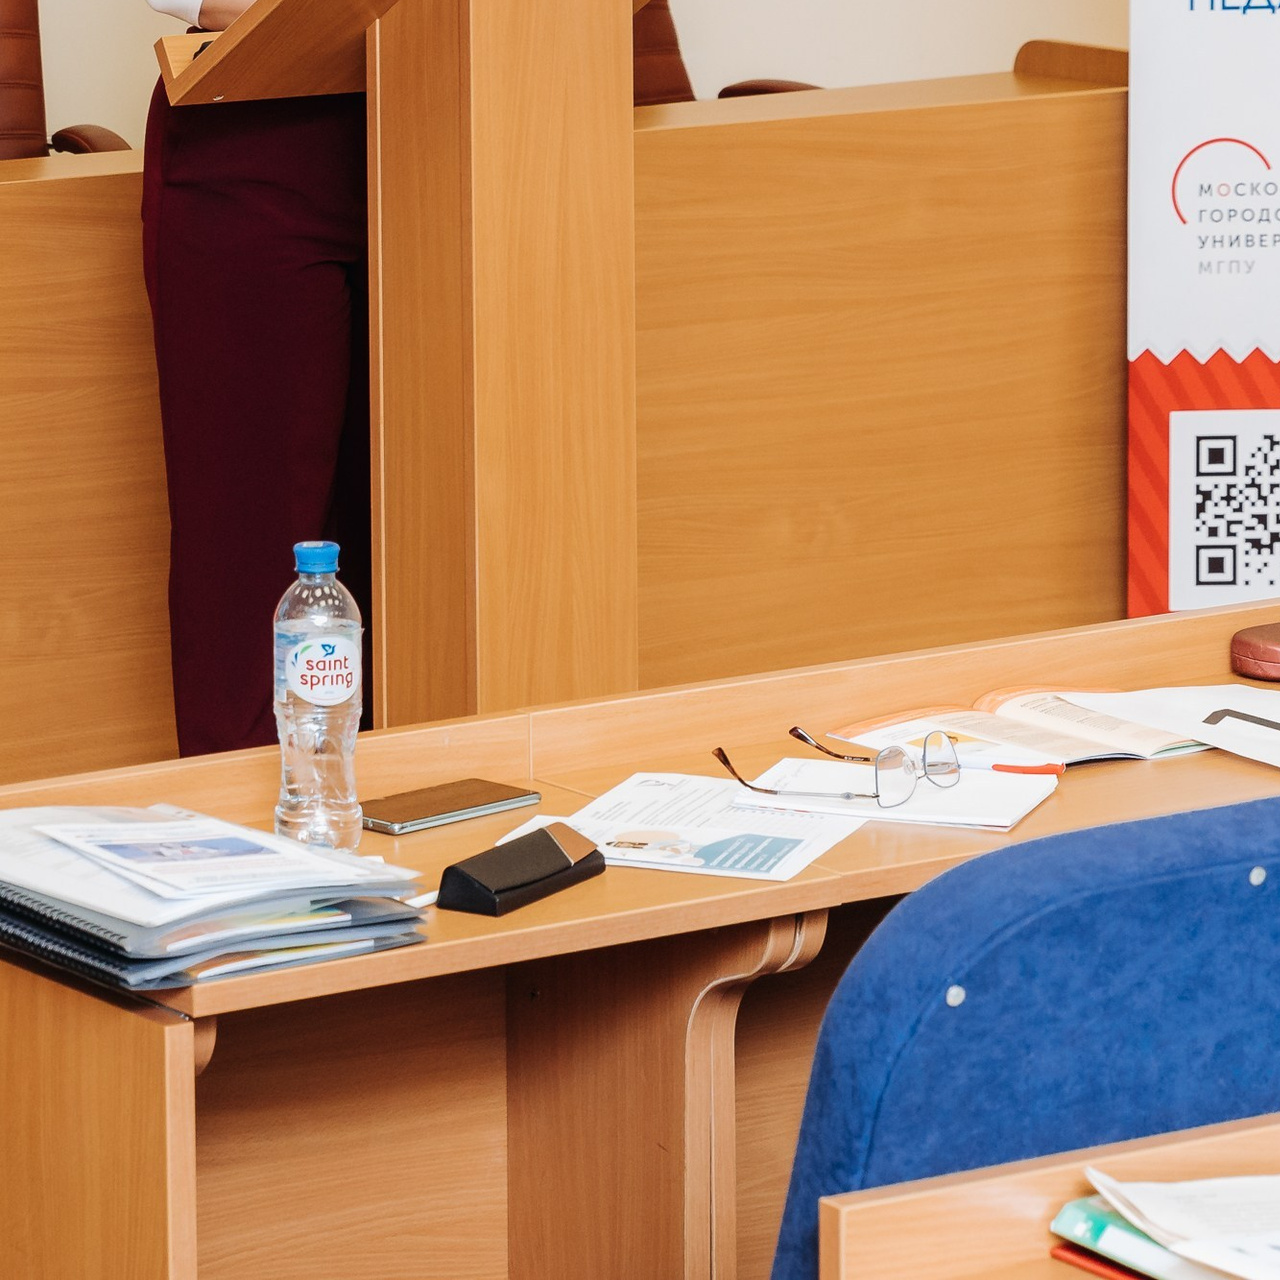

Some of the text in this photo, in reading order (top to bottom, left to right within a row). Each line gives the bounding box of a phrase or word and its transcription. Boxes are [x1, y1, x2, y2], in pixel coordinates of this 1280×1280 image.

[1198, 182, 1278, 198] МОСКО
[1198, 260, 1256, 275] МГПУ
[306, 655, 349, 671] saint
[300, 672, 353, 691] spring
